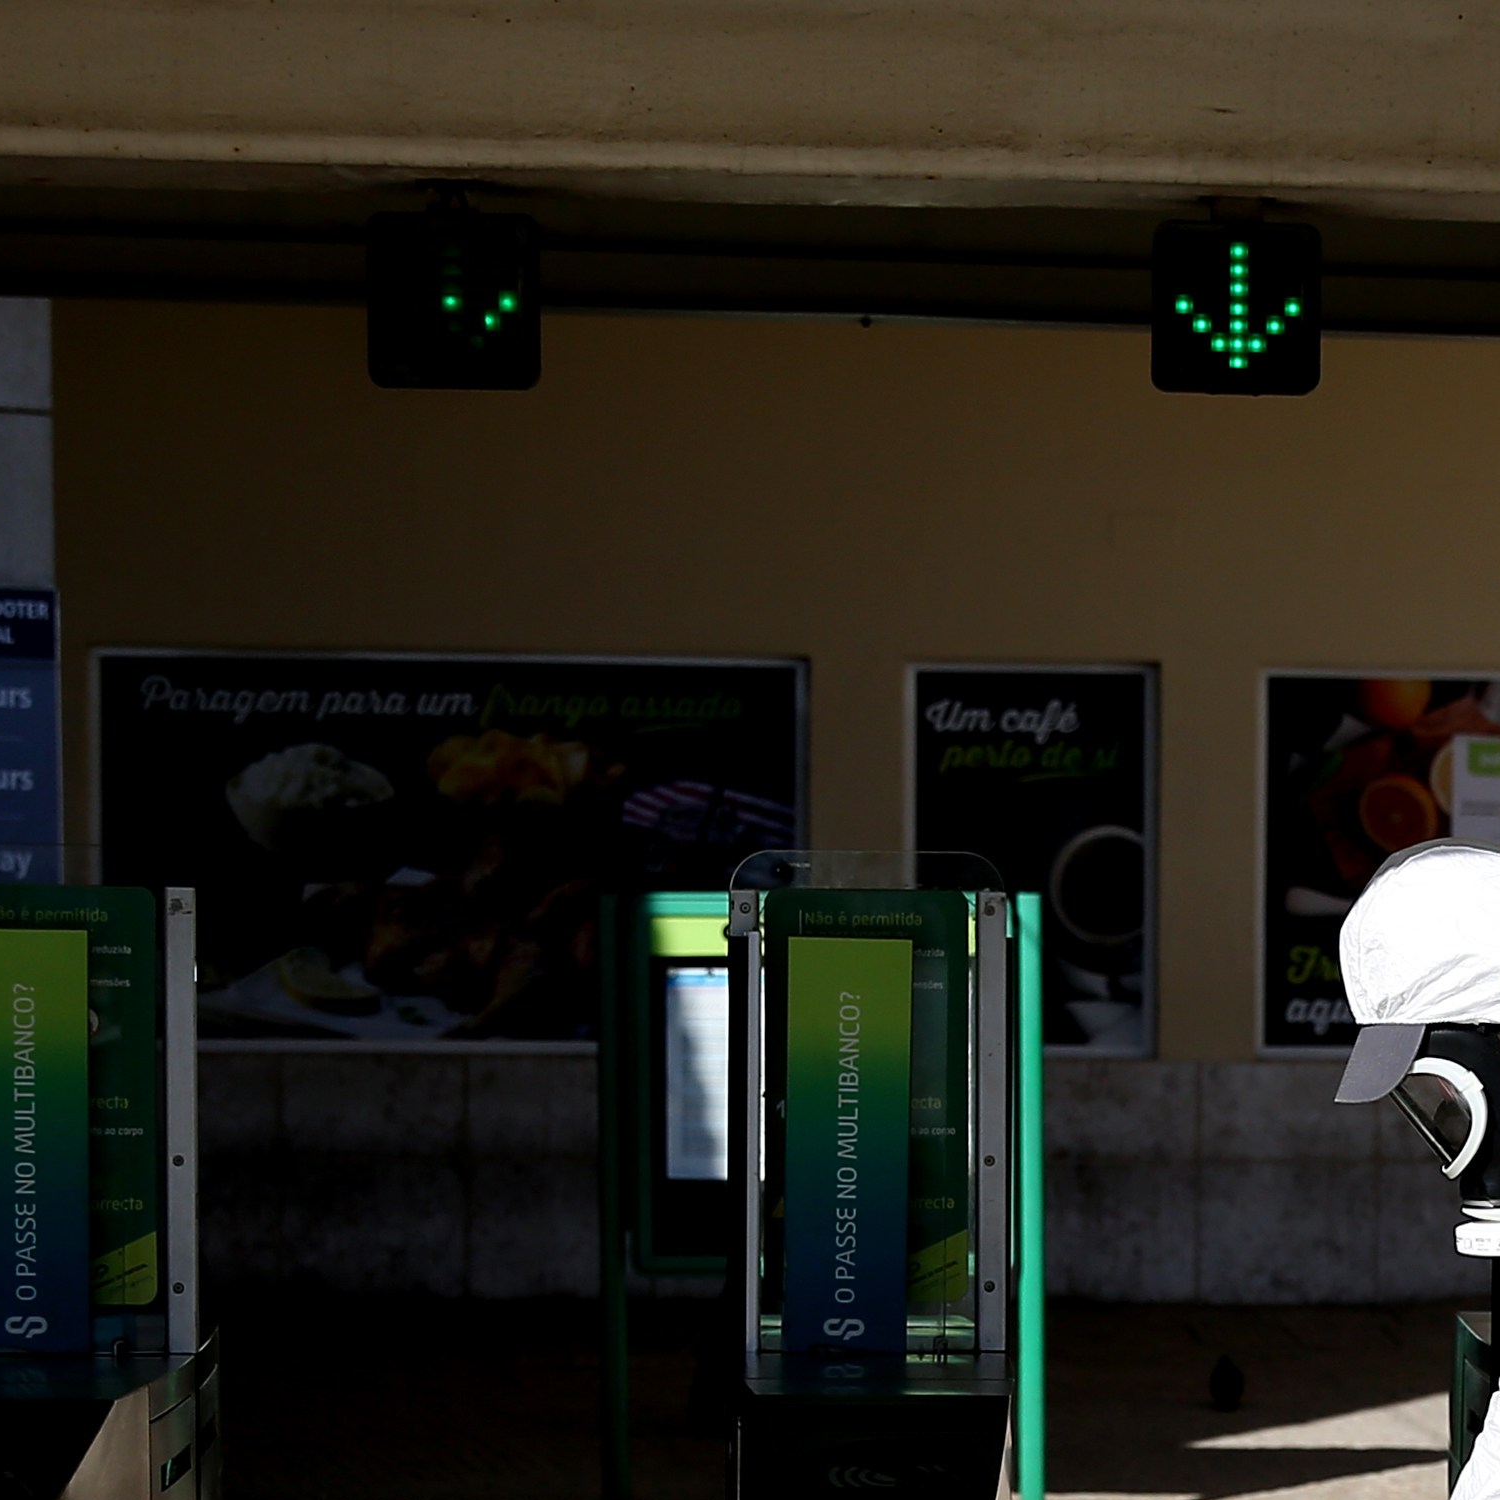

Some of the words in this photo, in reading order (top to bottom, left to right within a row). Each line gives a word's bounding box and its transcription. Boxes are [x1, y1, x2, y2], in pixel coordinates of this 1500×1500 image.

[140, 673, 316, 726] Paragem
[317, 686, 411, 721] para
[416, 688, 479, 718] um
[478, 682, 611, 730] frango
[620, 690, 744, 721] assado
[924, 697, 996, 734] Um
[999, 697, 1082, 745] café
[937, 738, 1033, 776] perto
[1041, 740, 1082, 770] de
[22, 904, 31, 922] é
[34, 905, 109, 926] permitida
[804, 911, 833, 926] Não
[838, 911, 849, 925] é
[851, 911, 923, 928] permitida
[90, 977, 131, 987] mensões
[12, 983, 36, 1155] MULTIBANCO?
[837, 990, 861, 1161] MULTIBANCO?
[91, 1095, 129, 1109] recta
[117, 1127, 144, 1137] corpo
[15, 1161, 37, 1196] NO
[836, 1166, 858, 1200] NO
[91, 1197, 144, 1211] orrecta
[15, 1202, 37, 1278] PASSE
[835, 1206, 857, 1281] PASSE
[15, 1283, 37, 1302] O
[834, 1287, 856, 1305] O
